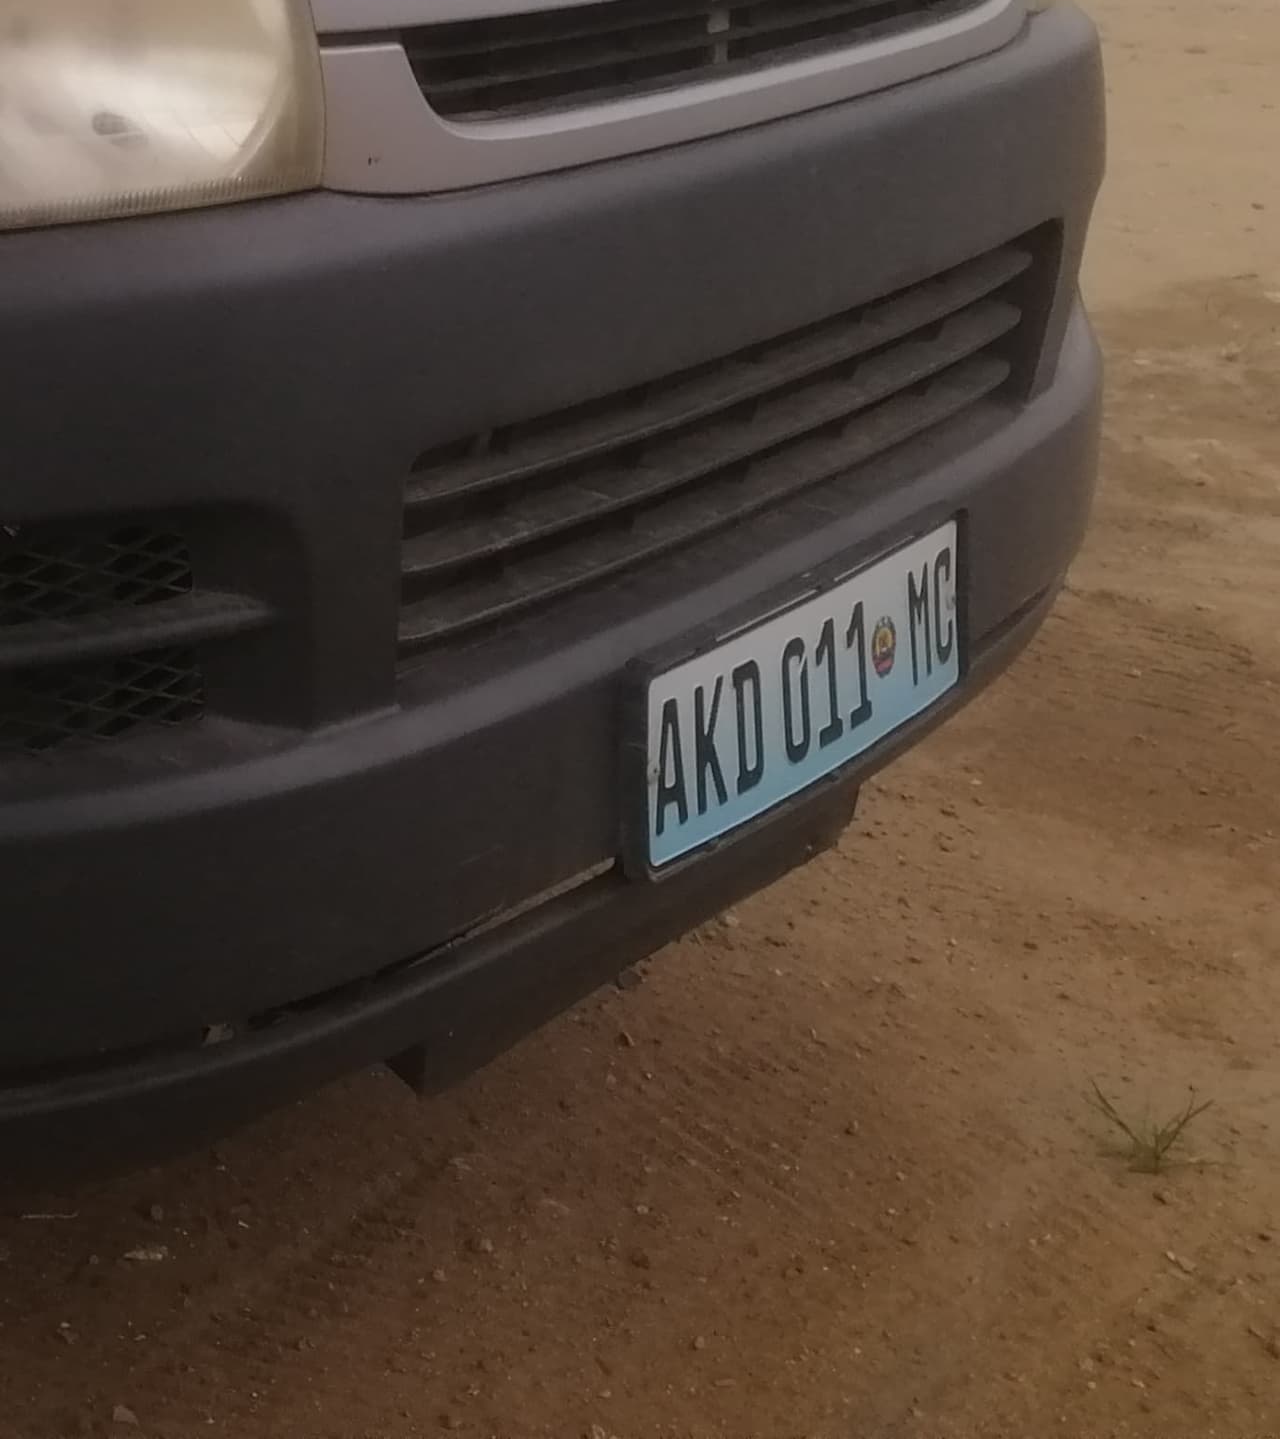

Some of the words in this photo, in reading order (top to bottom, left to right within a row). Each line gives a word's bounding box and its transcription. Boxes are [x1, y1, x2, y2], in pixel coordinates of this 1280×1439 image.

[655, 658, 764, 837] AKD
[781, 600, 873, 764] 011
[906, 545, 954, 687] MC
